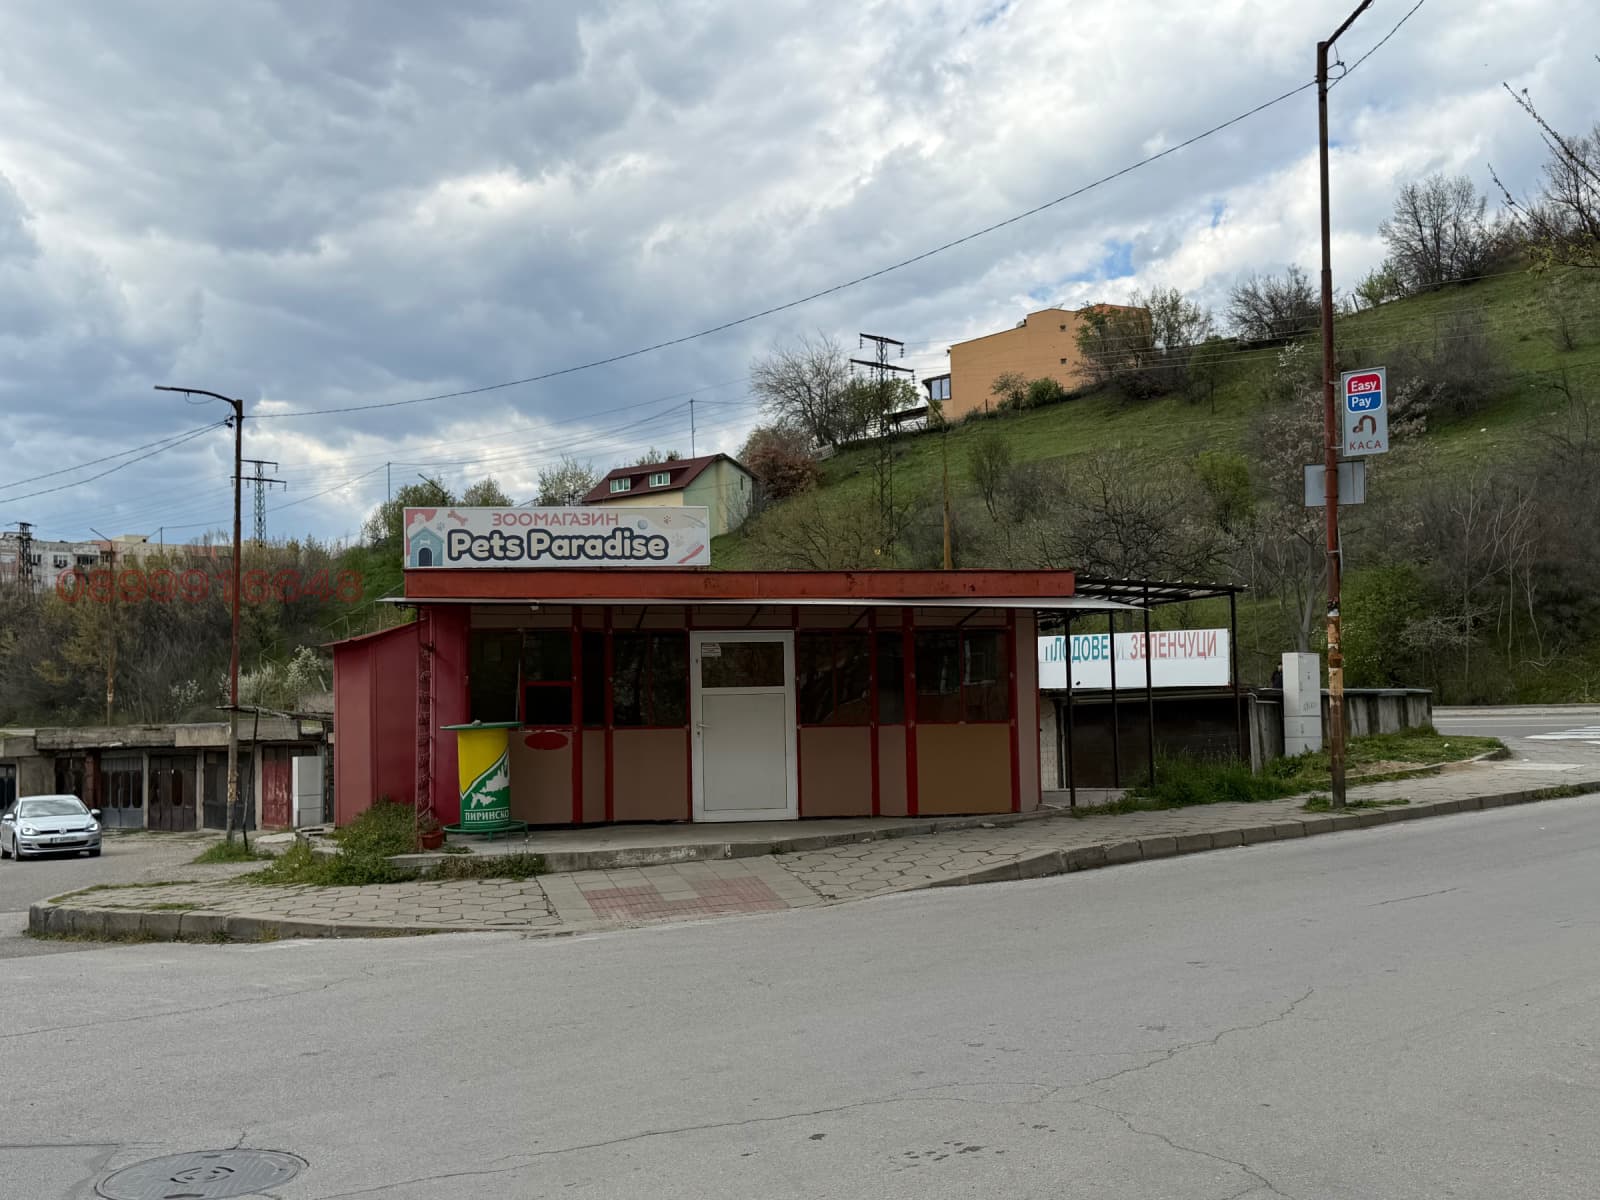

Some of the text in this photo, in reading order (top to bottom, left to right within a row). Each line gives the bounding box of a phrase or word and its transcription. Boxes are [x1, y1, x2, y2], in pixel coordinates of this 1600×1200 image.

[1351, 380, 1377, 392] Easy
[1351, 396, 1372, 408] Pay
[1350, 440, 1383, 450] КАСА
[492, 512, 619, 527] ЗООМАГАЗИН
[448, 527, 669, 561] Pets Paradise
